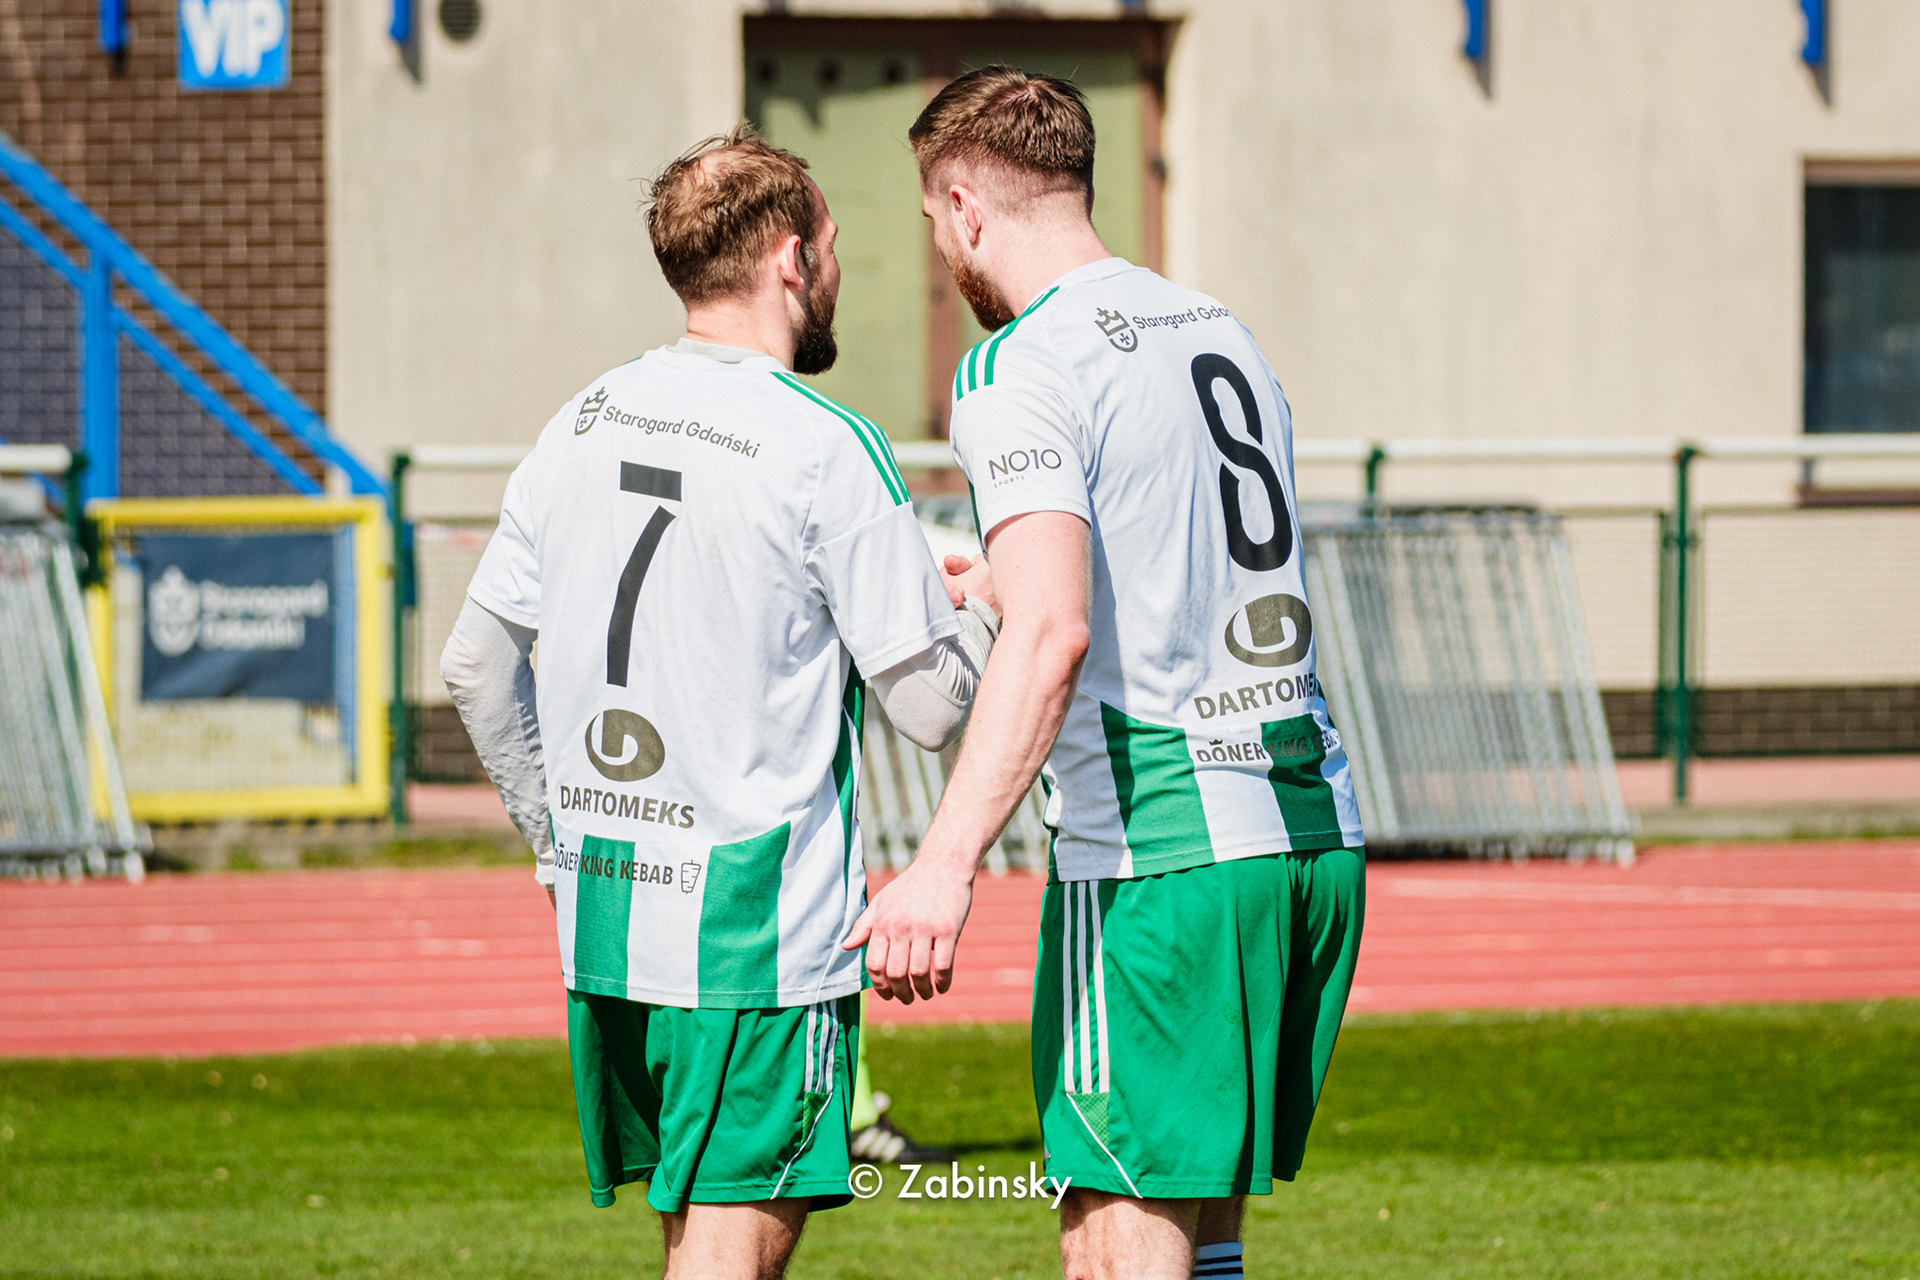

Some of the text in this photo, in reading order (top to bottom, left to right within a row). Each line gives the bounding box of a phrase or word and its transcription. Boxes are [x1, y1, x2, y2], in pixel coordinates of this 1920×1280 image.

[180, 0, 285, 78] VIP
[1132, 308, 1198, 330] Starogard
[603, 405, 760, 458] Starogard Gdański
[993, 475, 1025, 489] SPORTS
[1191, 353, 1293, 572] 8
[607, 460, 682, 688] 7
[1266, 737, 1308, 759] KING
[560, 785, 695, 829] DARTOMEKS
[580, 854, 614, 879] KING
[619, 860, 674, 885] KEBAB
